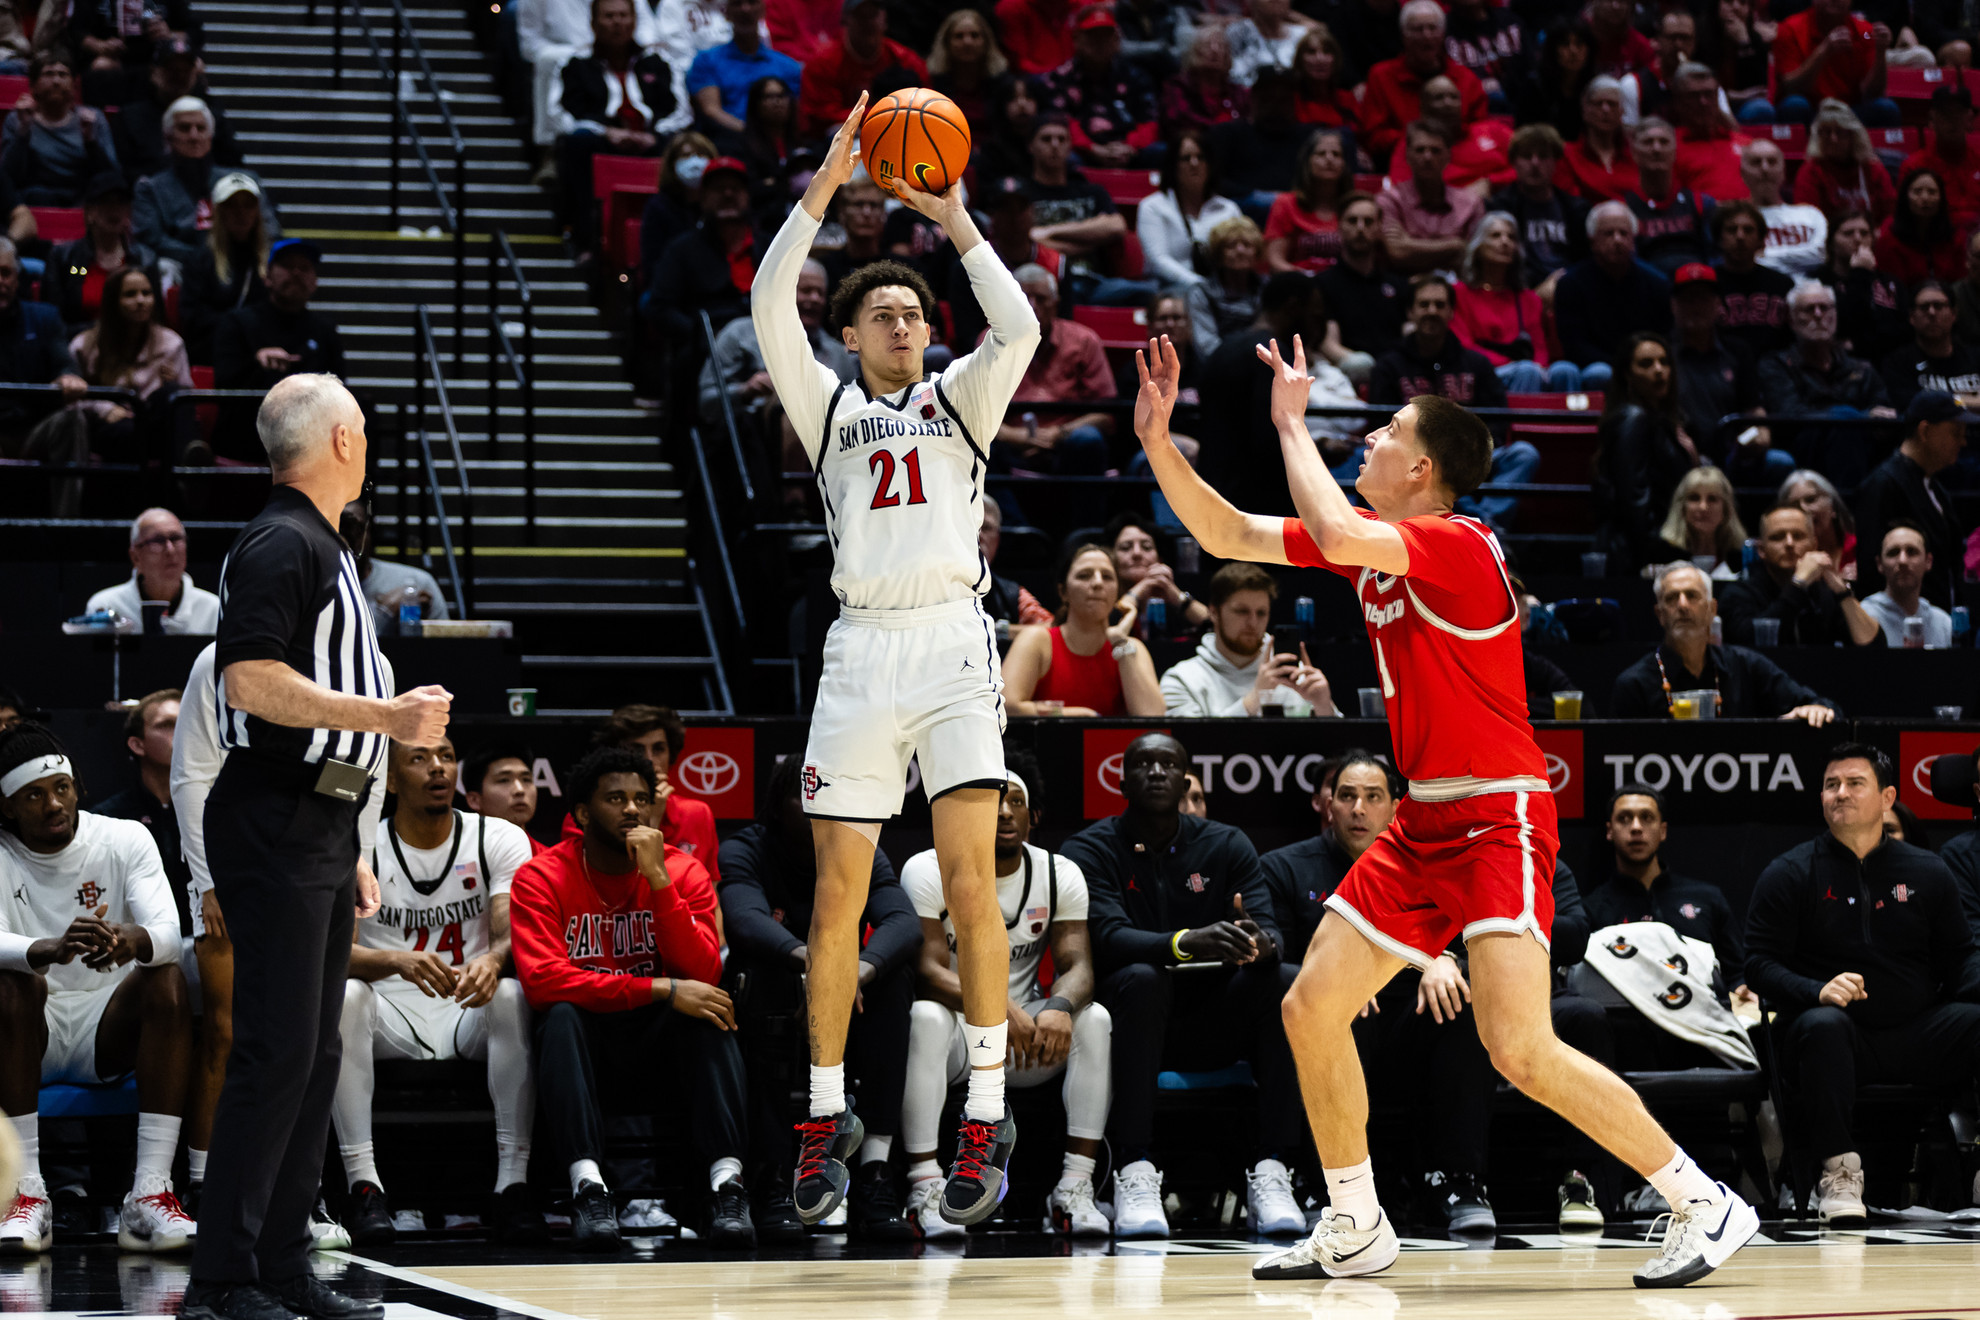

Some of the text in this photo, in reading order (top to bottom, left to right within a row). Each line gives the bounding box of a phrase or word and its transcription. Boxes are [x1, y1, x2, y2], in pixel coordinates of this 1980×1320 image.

[839, 416, 953, 452] SAN DIEGO STATE
[868, 446, 927, 510] 21
[1604, 753, 1804, 792] TOYOTA
[377, 894, 483, 930] SAN DIEGO STATE
